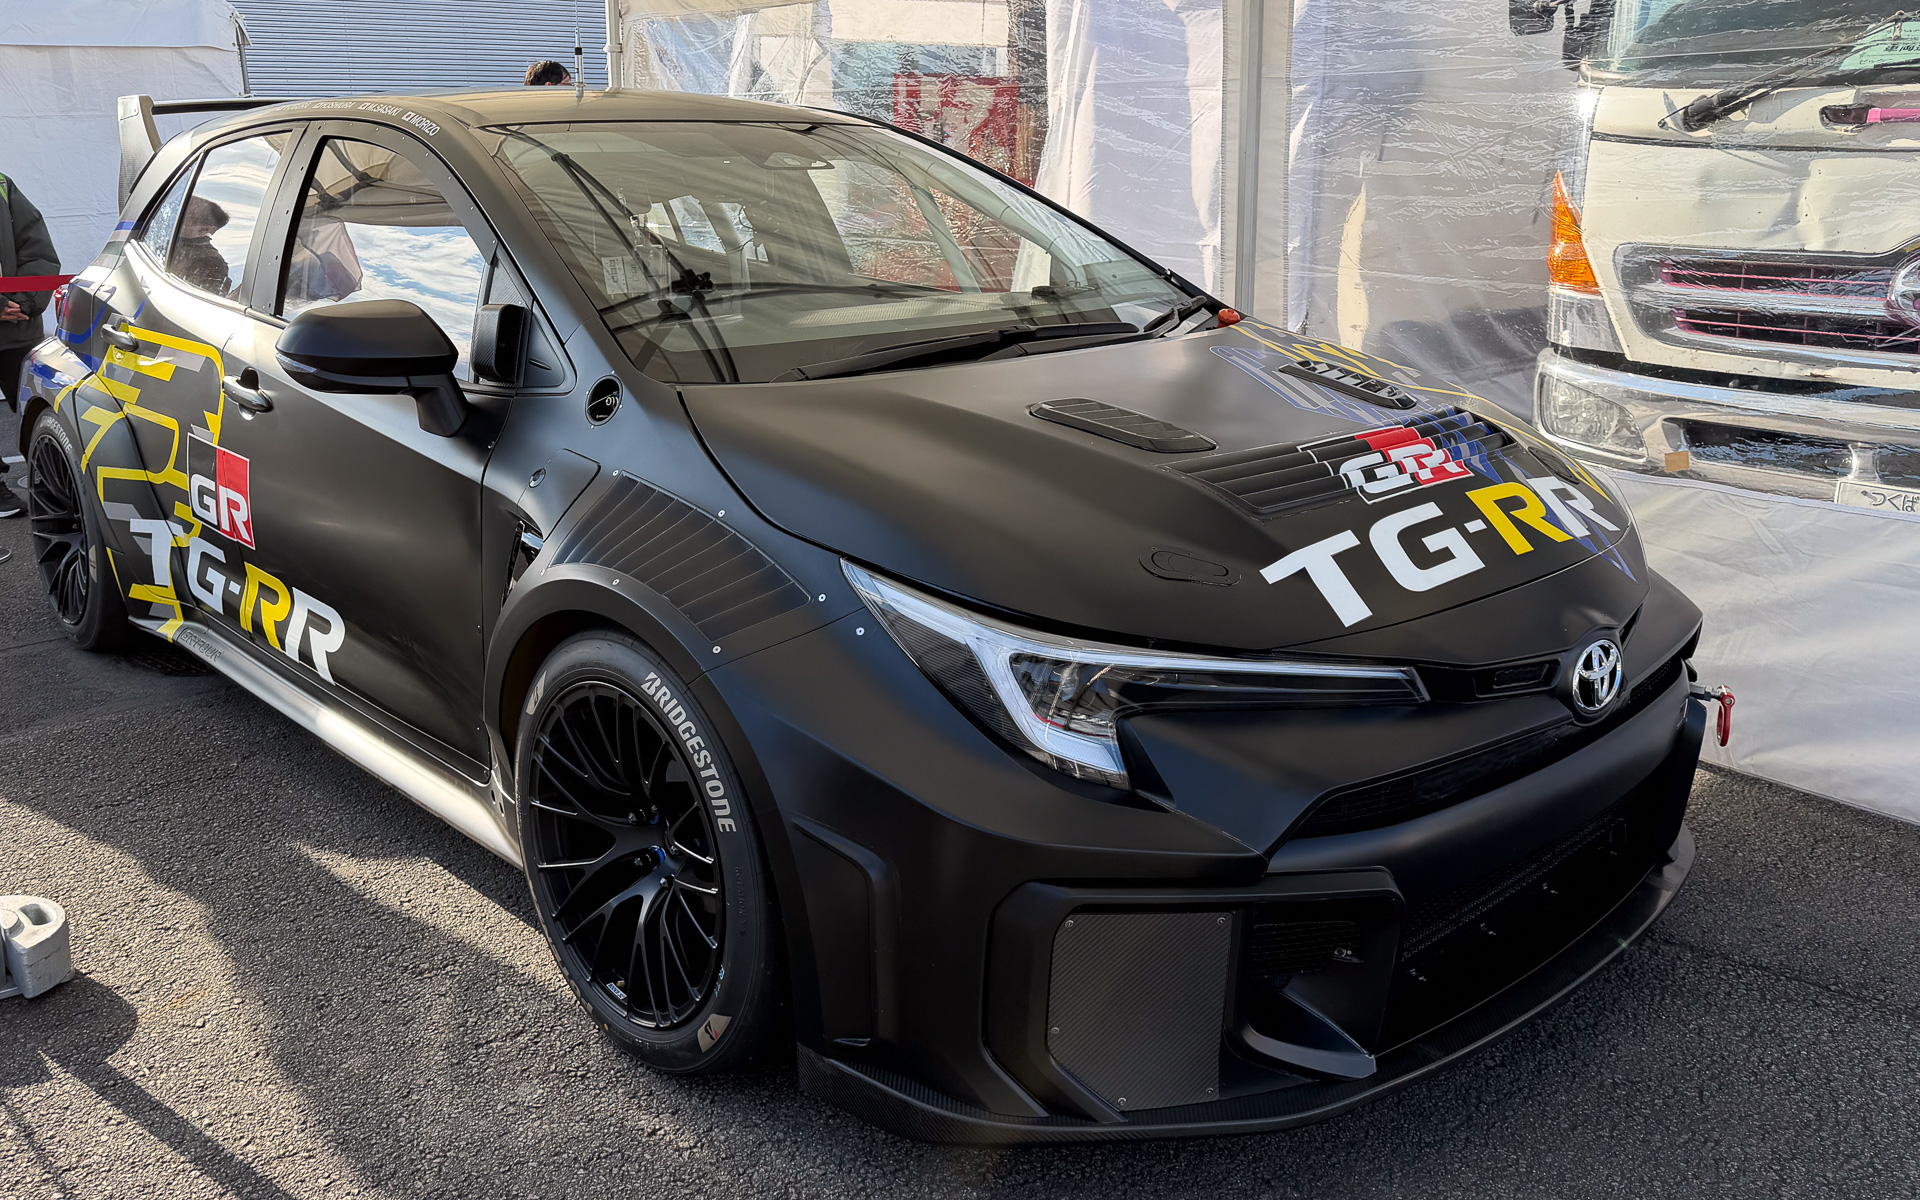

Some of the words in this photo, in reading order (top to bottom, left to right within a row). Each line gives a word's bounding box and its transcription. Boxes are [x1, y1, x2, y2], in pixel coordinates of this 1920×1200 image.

[366, 103, 403, 116] M.SASAKI
[409, 114, 441, 137] MORIZO
[1340, 443, 1465, 494] GR
[190, 473, 252, 543] GR
[1871, 490, 1920, 512] つくば
[1259, 475, 1621, 628] TG-RR
[129, 518, 346, 686] TG-RR
[640, 672, 737, 833] BRIDGESTONE
